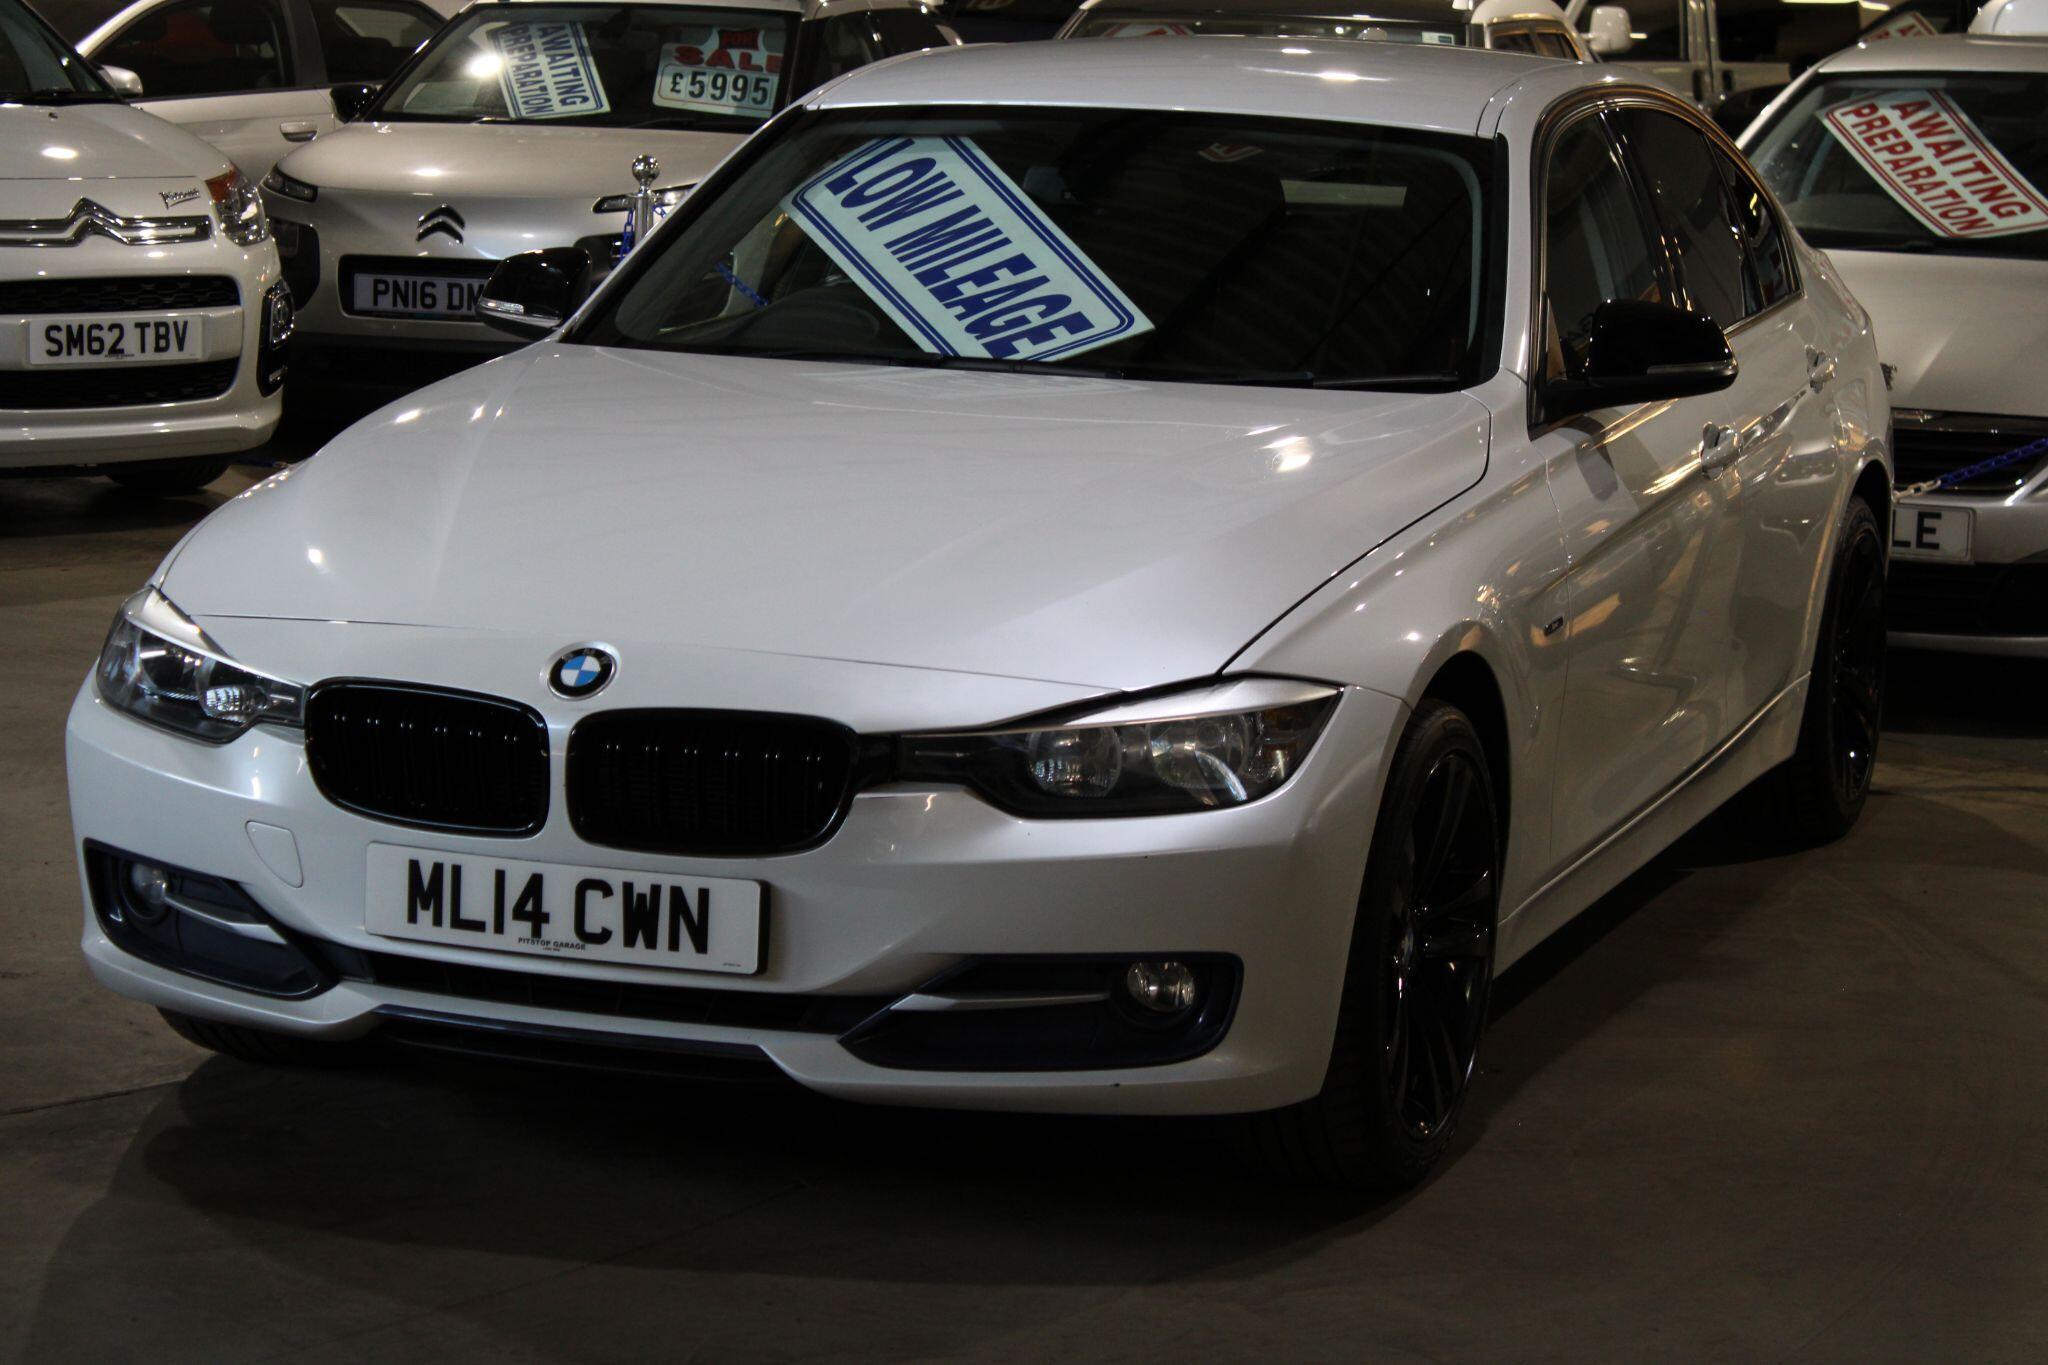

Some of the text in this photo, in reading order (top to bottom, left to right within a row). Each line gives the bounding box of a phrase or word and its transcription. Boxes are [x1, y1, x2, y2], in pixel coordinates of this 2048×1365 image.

[500, 25, 555, 115] PREPARATION
[538, 25, 590, 107] AWAITING
[670, 71, 770, 105] £5995
[672, 46, 783, 73] SALE
[1841, 102, 1995, 232] PREPARATION
[1890, 100, 2032, 219] AWAITING
[825, 138, 1095, 360] LOW MILEAGE
[373, 278, 437, 310] PN16
[45, 320, 188, 357] SM62 TBV
[407, 859, 710, 955] ML14 CWN
[518, 937, 551, 947] PITSTOP
[553, 941, 587, 951] GARAGE
